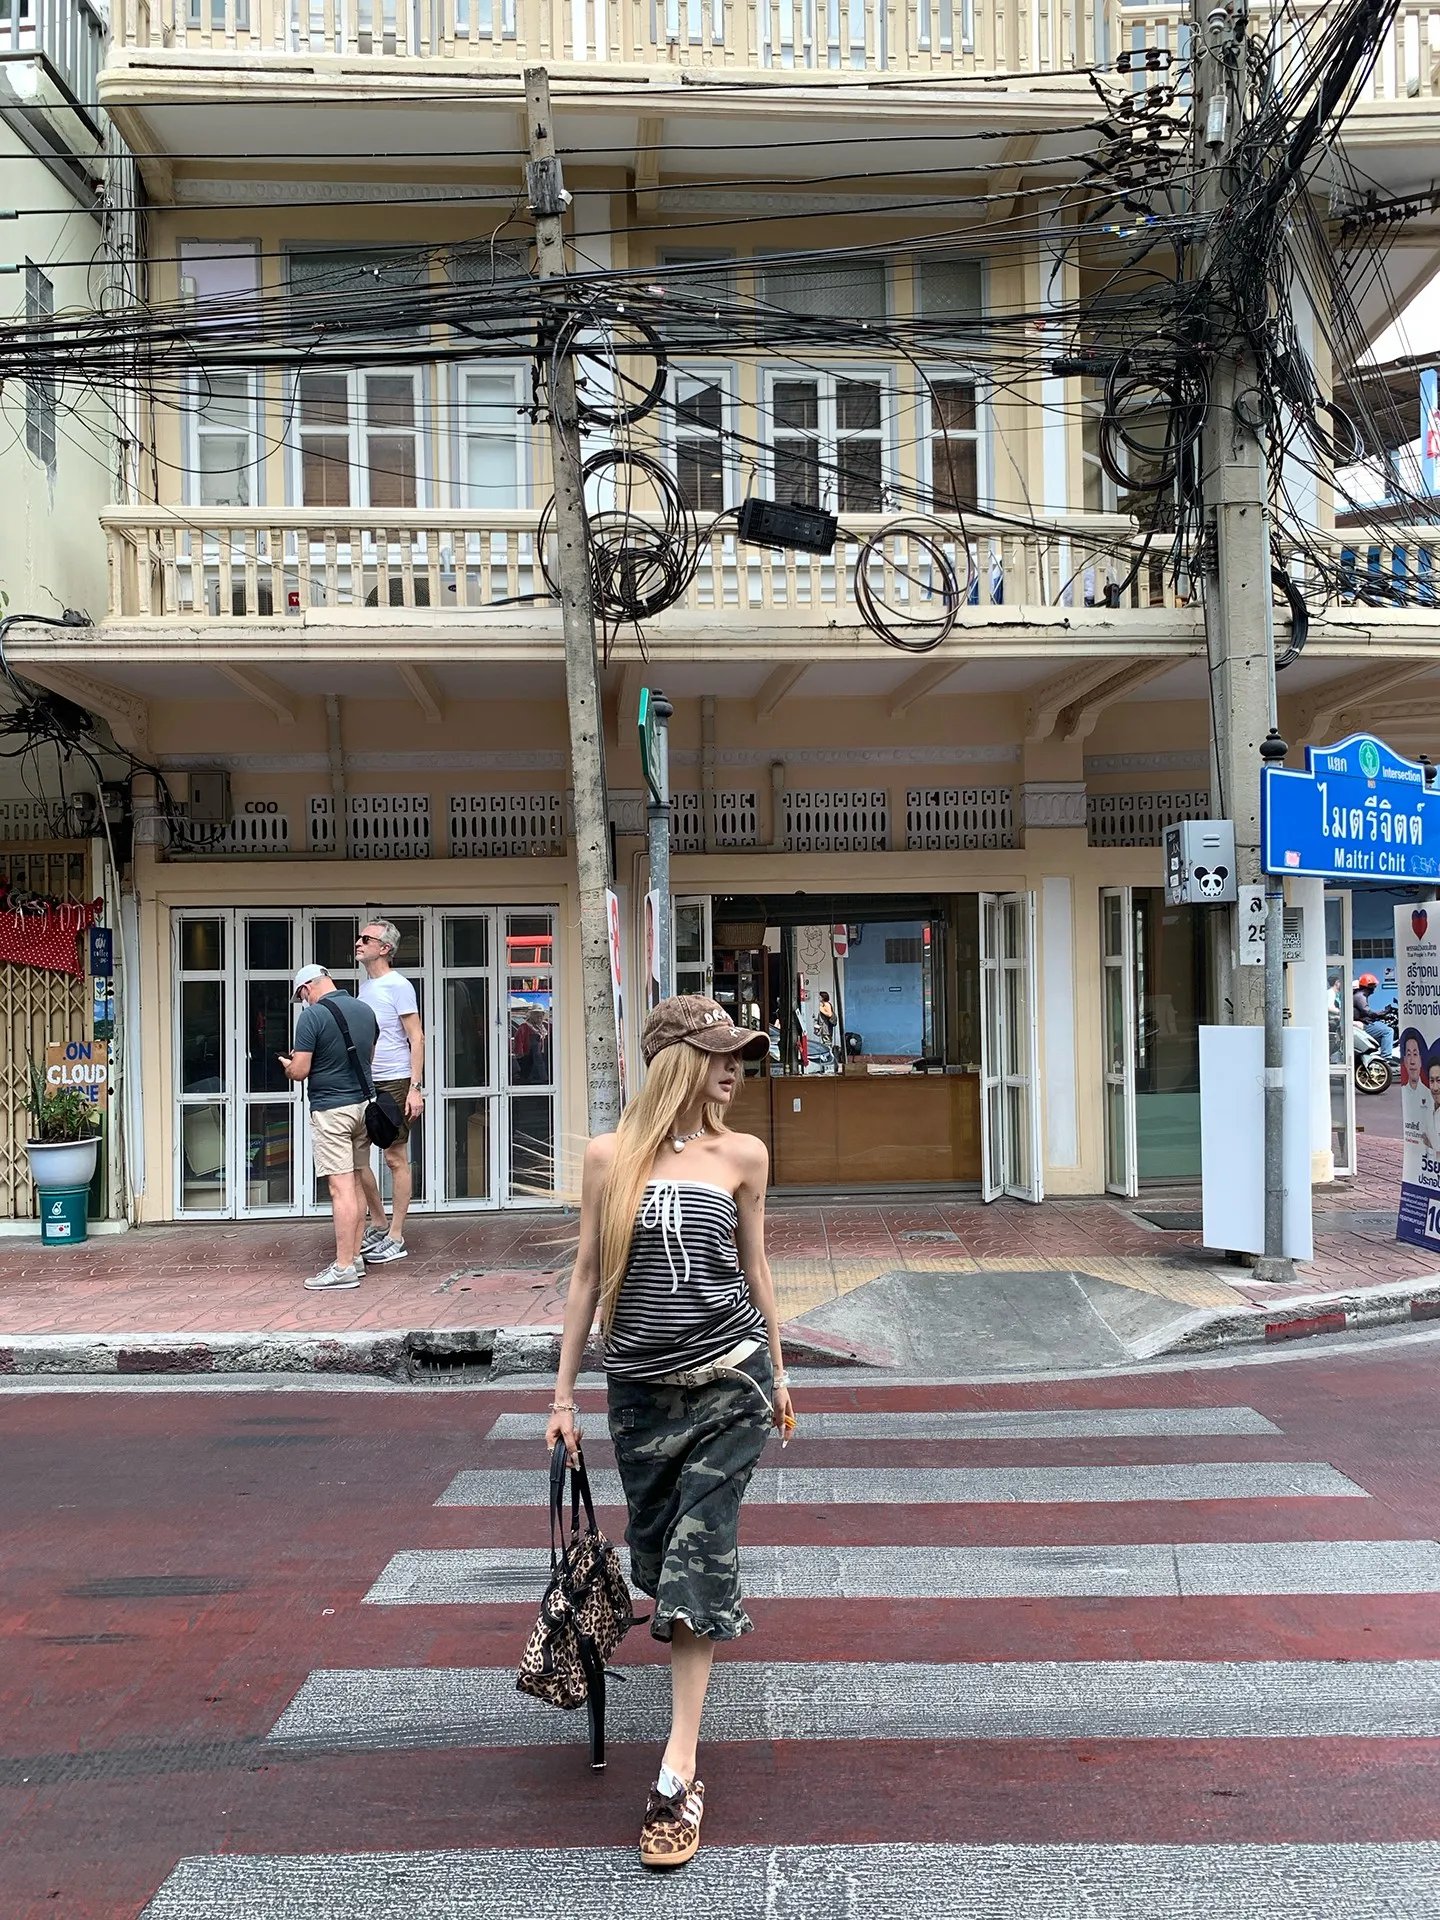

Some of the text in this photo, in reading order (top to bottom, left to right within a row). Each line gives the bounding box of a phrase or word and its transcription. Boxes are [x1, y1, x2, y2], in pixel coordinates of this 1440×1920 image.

[1327, 756, 1347, 772] แยก
[1382, 765, 1421, 783] Intersection
[245, 801, 279, 814] COO
[1317, 782, 1425, 845] ไมตรีจิตต์
[1334, 848, 1374, 870] Maitri
[1379, 851, 1406, 872] Chit
[1407, 963, 1438, 978] สร้างคน
[1403, 1000, 1440, 1016] สร้างอาชี
[47, 1064, 107, 1085] CLOUD
